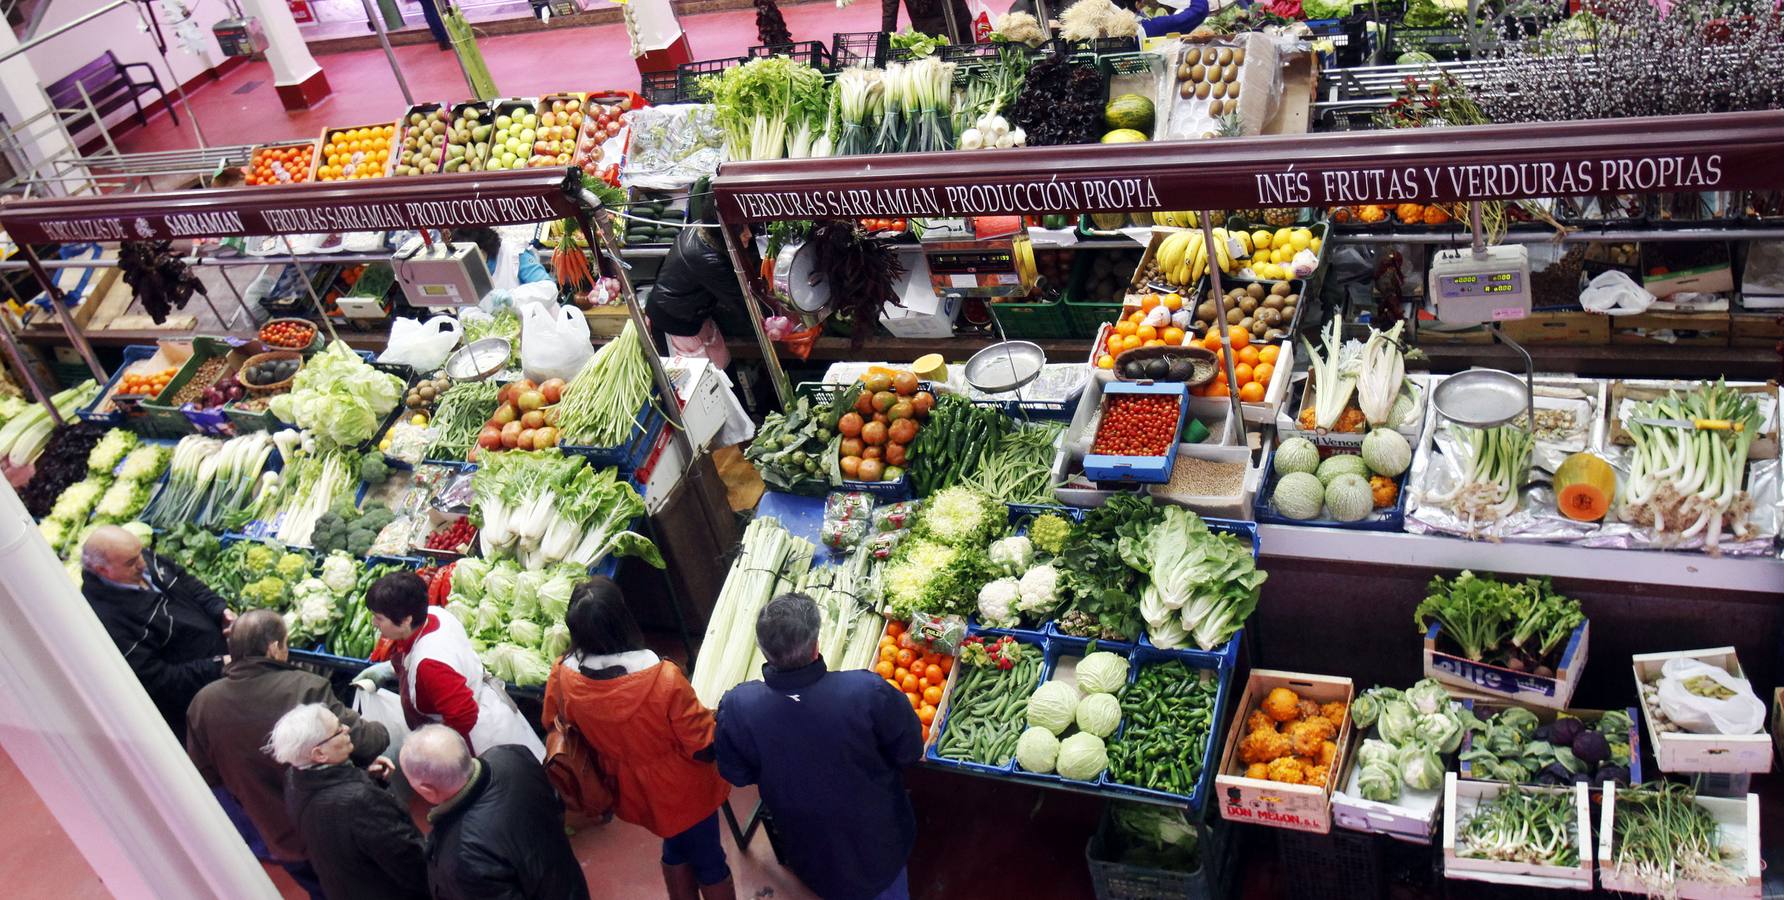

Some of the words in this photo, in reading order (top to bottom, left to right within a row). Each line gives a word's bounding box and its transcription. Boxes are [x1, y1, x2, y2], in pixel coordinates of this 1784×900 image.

[1255, 164, 1311, 204] INÉS
[1322, 168, 1419, 202] FRUTAS
[1424, 167, 1441, 198] Y
[1448, 160, 1593, 198] VERDURAS
[1600, 155, 1722, 191] PROPIAS
[260, 207, 330, 232] VERDURAS
[325, 203, 410, 231] SARRAMIAN,
[405, 192, 500, 228] PRODUCCIÓN
[496, 196, 558, 222] PROPIA
[733, 191, 828, 218] VERDURAS
[826, 187, 946, 217] SARRAMIAN,
[945, 174, 1080, 214] PRODUCCIÓN
[1081, 177, 1162, 210] PROPIA
[40, 218, 111, 241] HORTALIZAS
[106, 217, 129, 239] DE
[164, 211, 246, 236] SARRAMIAN
[1226, 806, 1252, 817] DON
